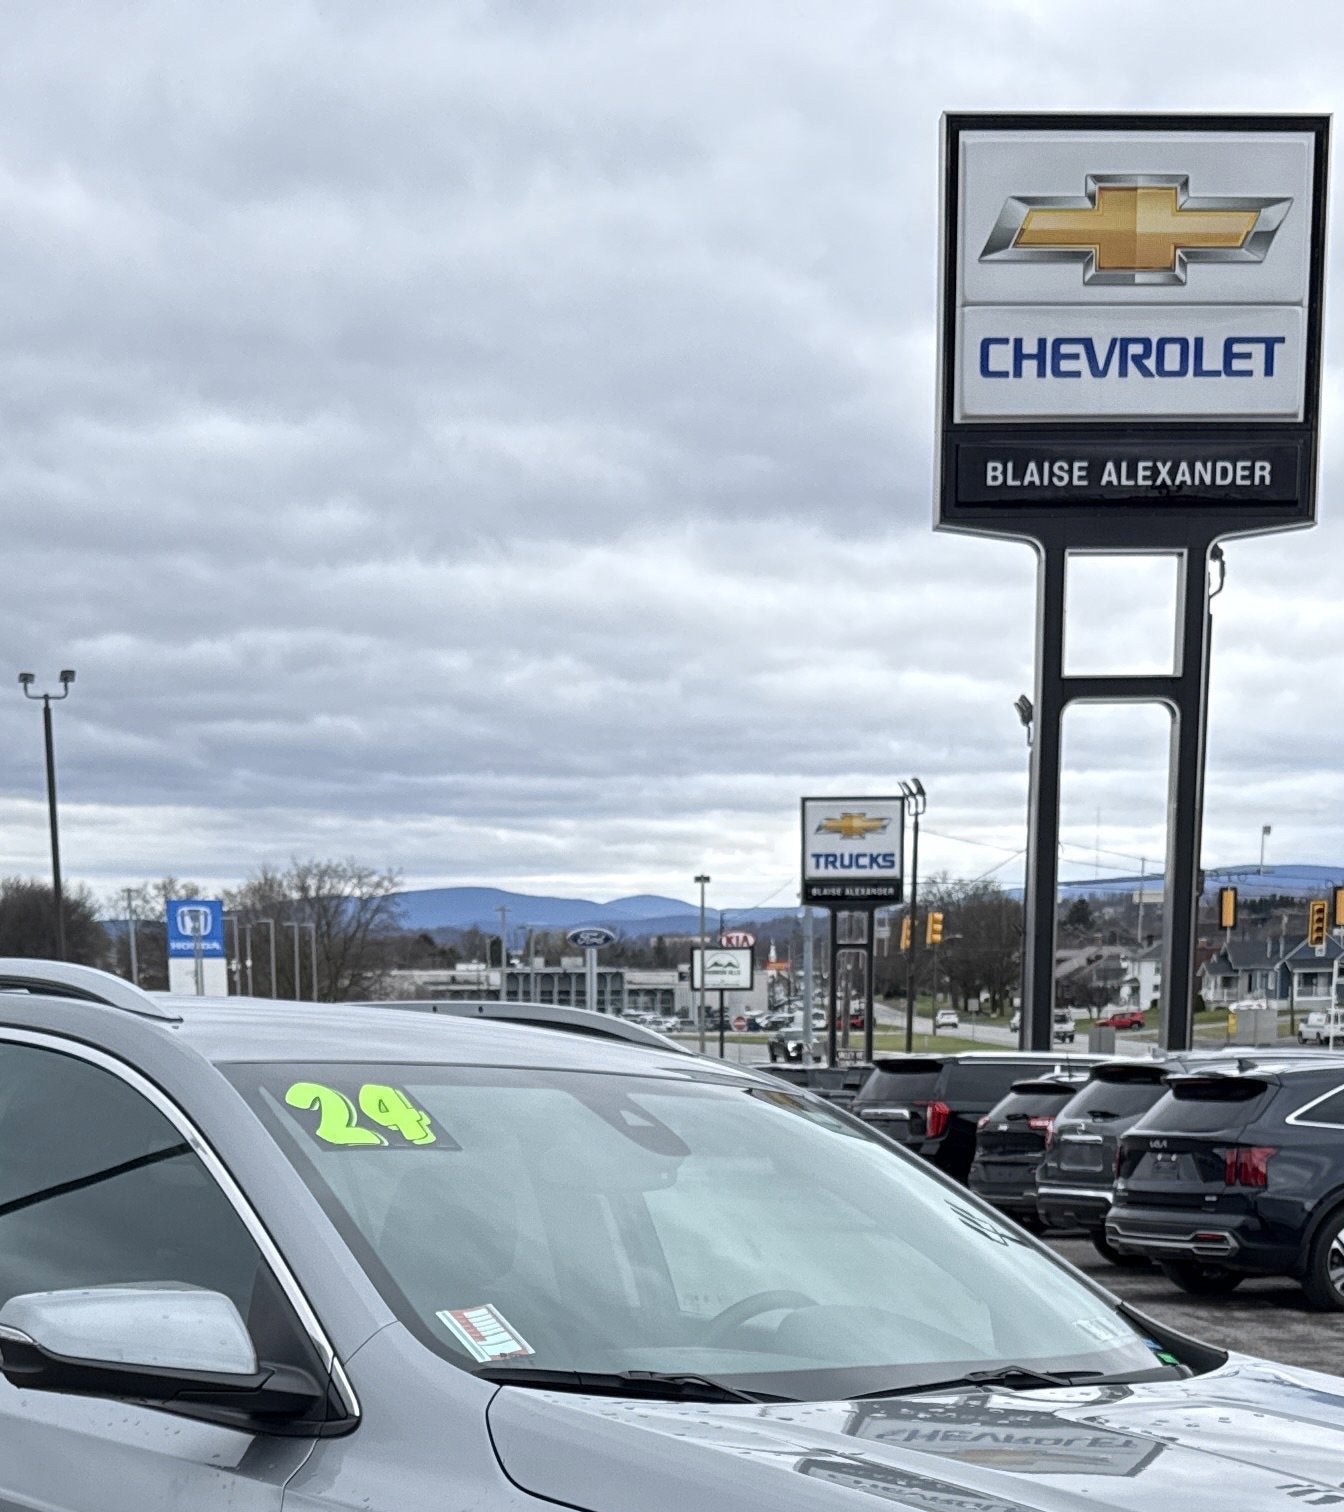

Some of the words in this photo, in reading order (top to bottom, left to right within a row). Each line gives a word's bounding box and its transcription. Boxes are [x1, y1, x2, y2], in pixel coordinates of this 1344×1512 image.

[979, 336, 1286, 379] CHEVROLET
[986, 460, 1088, 488] BLAISE
[1100, 459, 1272, 487] ALEXANDER
[810, 852, 896, 870] TRUCKS
[724, 934, 749, 948] KIA
[285, 1082, 437, 1147] 24
